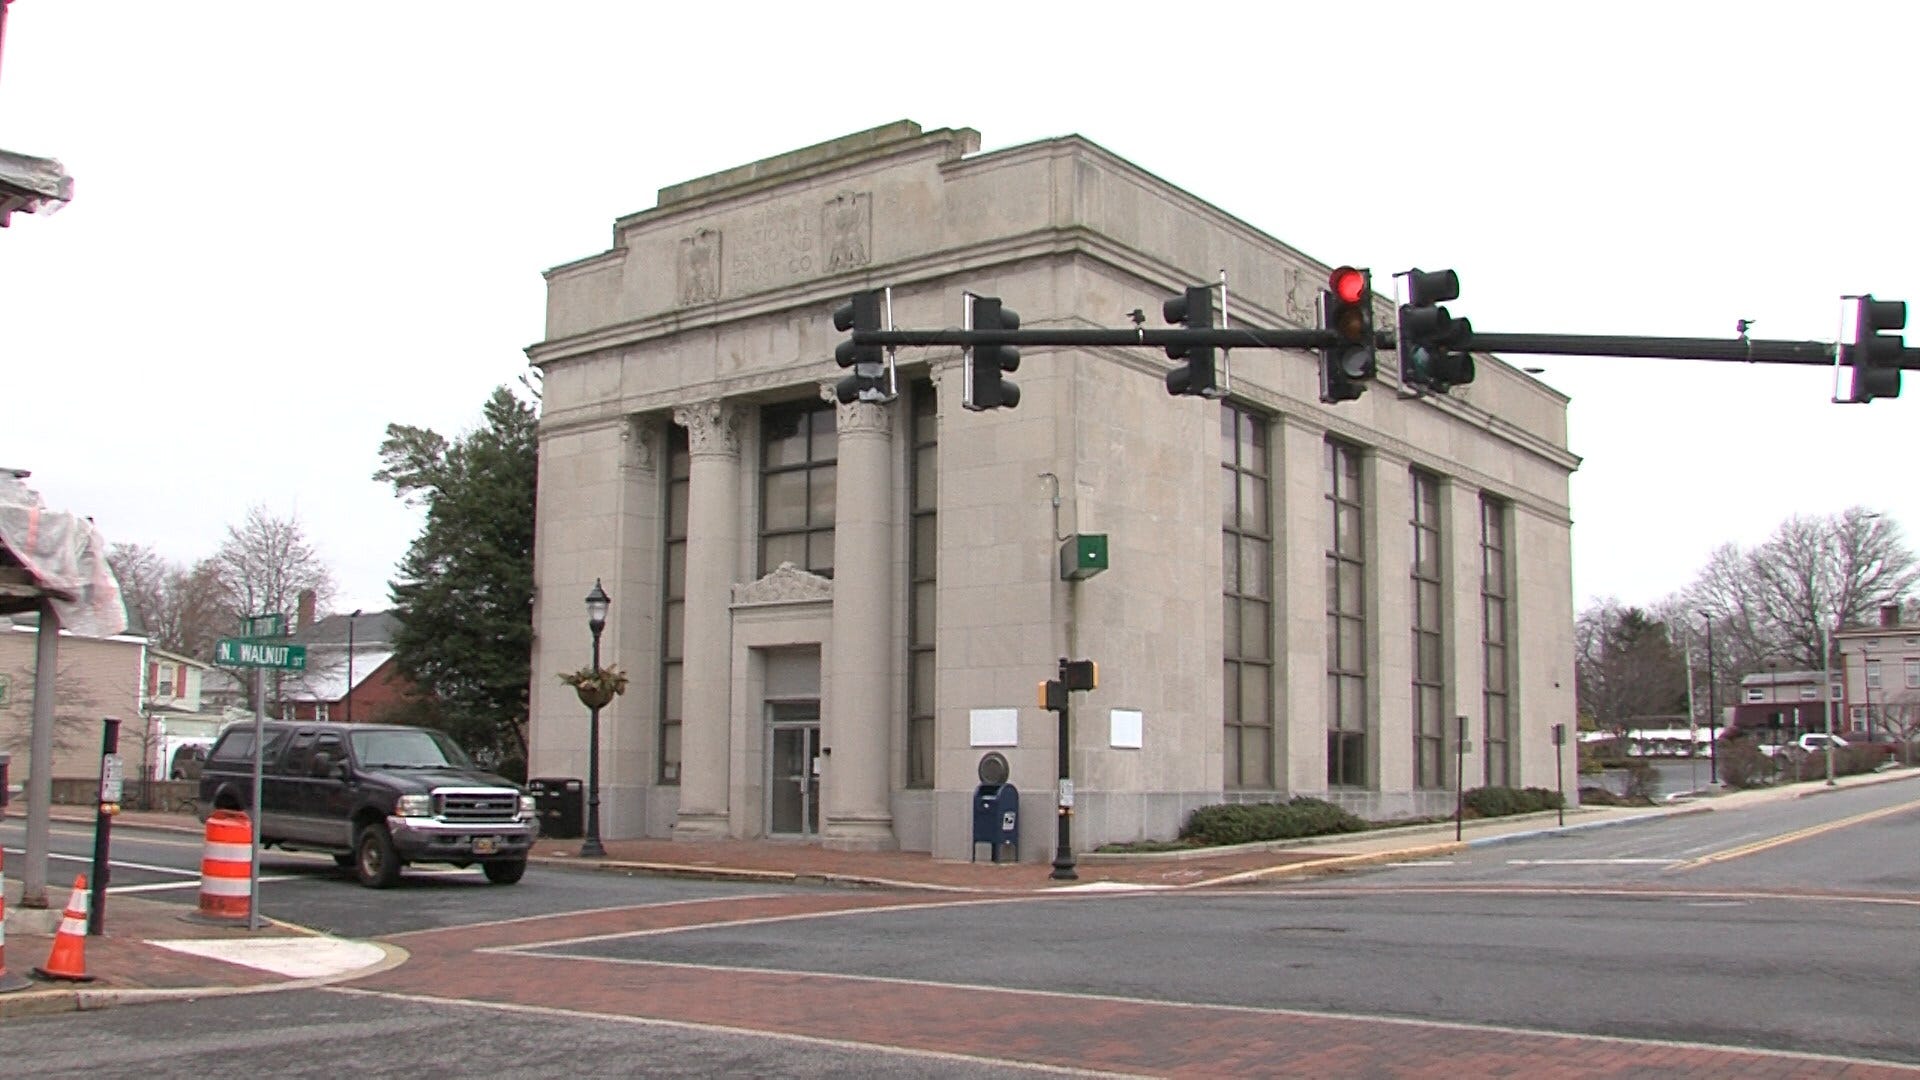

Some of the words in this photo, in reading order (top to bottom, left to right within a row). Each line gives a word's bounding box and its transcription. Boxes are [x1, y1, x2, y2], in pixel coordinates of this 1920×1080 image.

[221, 642, 235, 661] N.
[240, 642, 290, 666] WALNUT
[292, 656, 304, 667] ST
